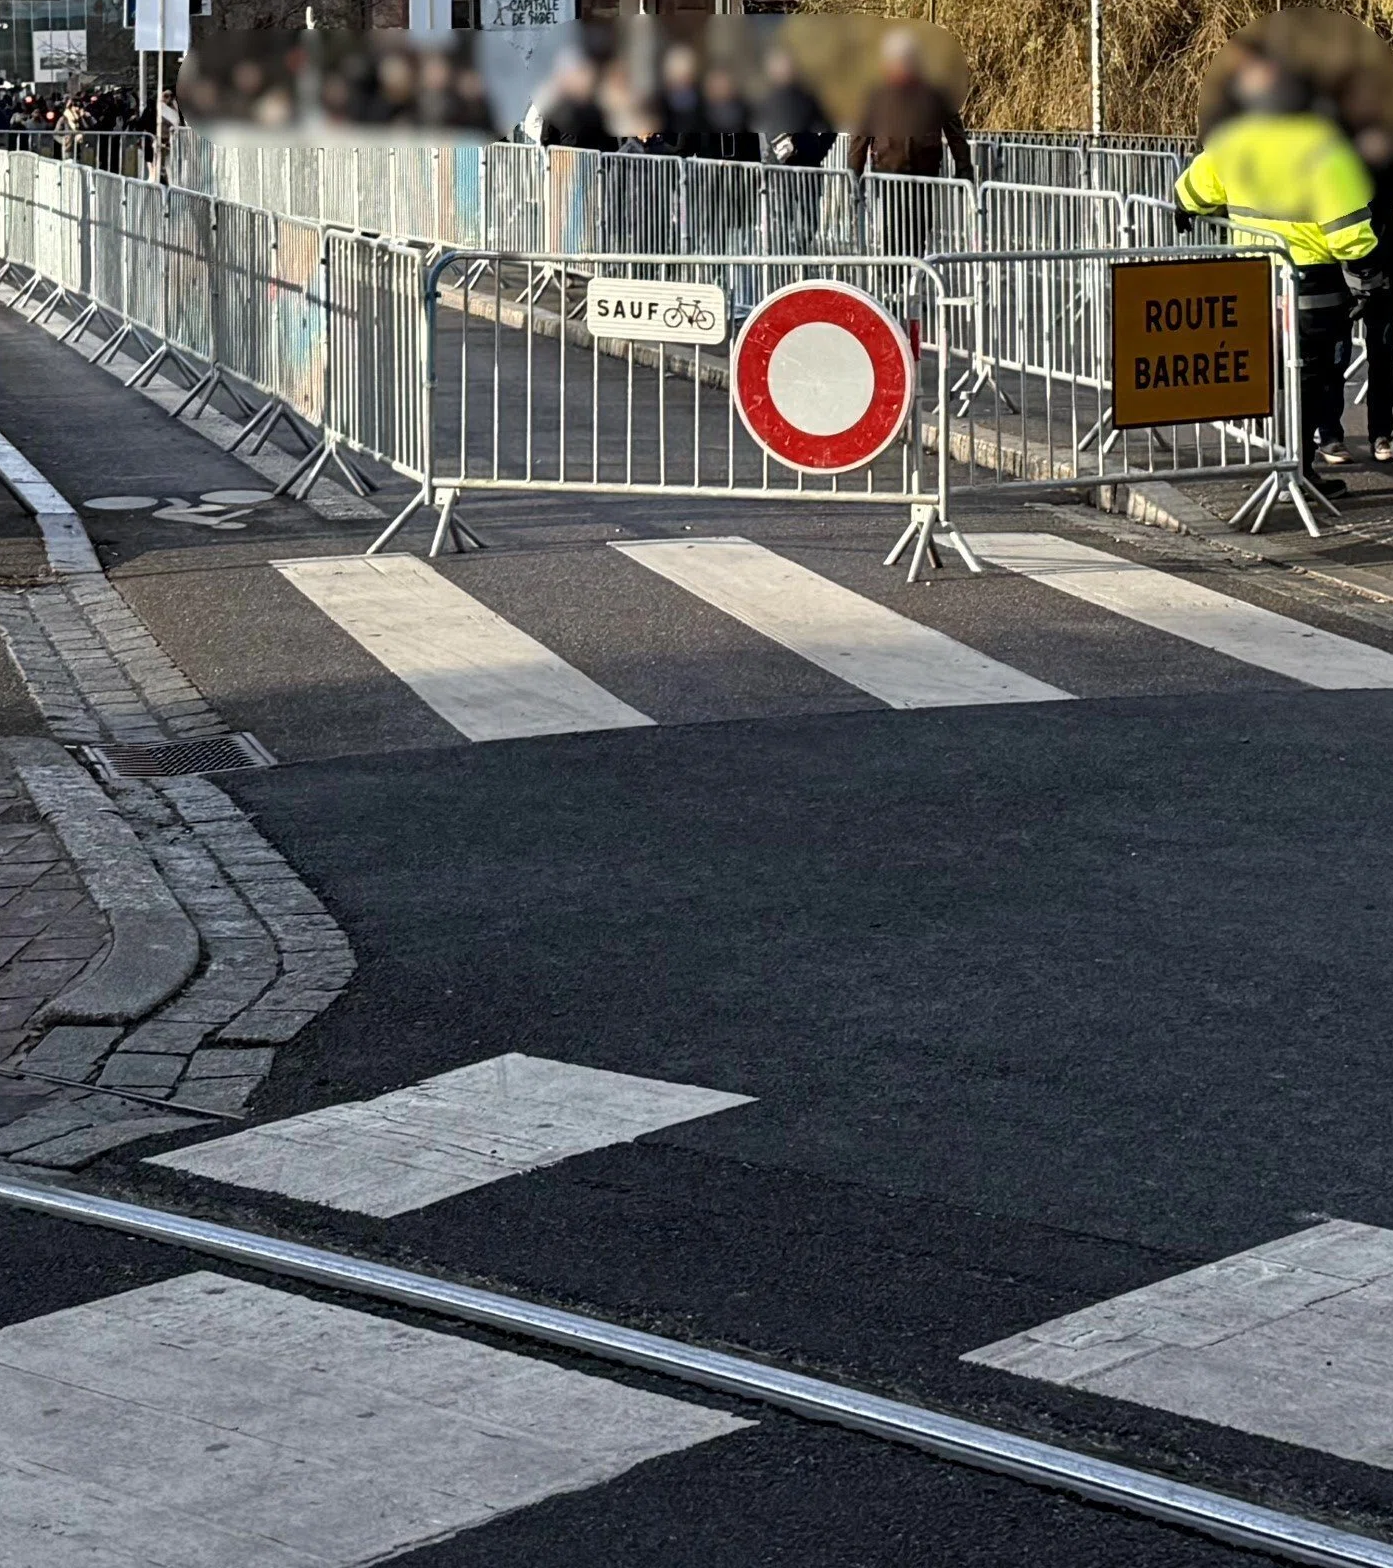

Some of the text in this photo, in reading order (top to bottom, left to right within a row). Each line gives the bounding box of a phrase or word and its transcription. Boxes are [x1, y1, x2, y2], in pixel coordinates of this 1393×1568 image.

[512, 12, 526, 26] DE
[597, 299, 659, 320] SAUF
[1145, 295, 1238, 333] ROUTE
[1134, 340, 1250, 390] BARRÉE
